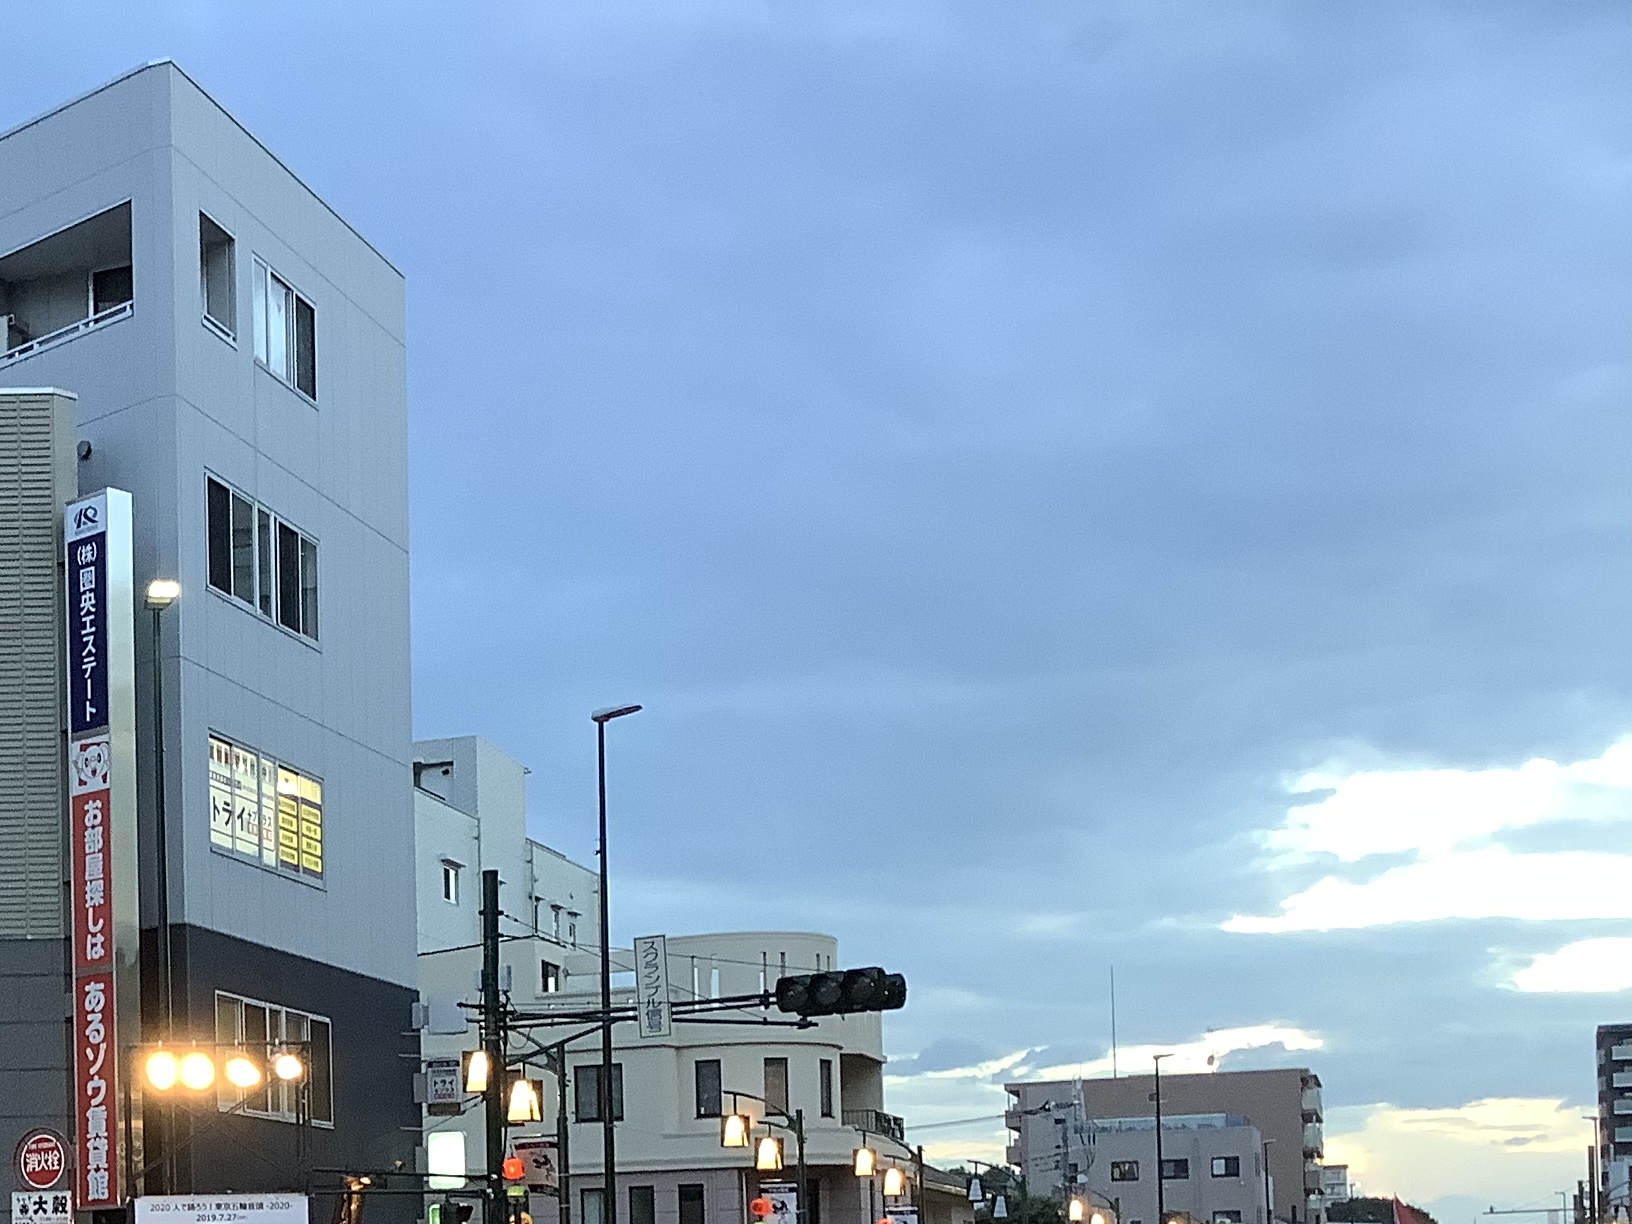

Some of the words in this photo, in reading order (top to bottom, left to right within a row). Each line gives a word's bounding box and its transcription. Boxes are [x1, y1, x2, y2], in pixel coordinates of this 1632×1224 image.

[83, 799, 105, 961] お部屋探しは
[25, 1149, 60, 1172] 消火栓
